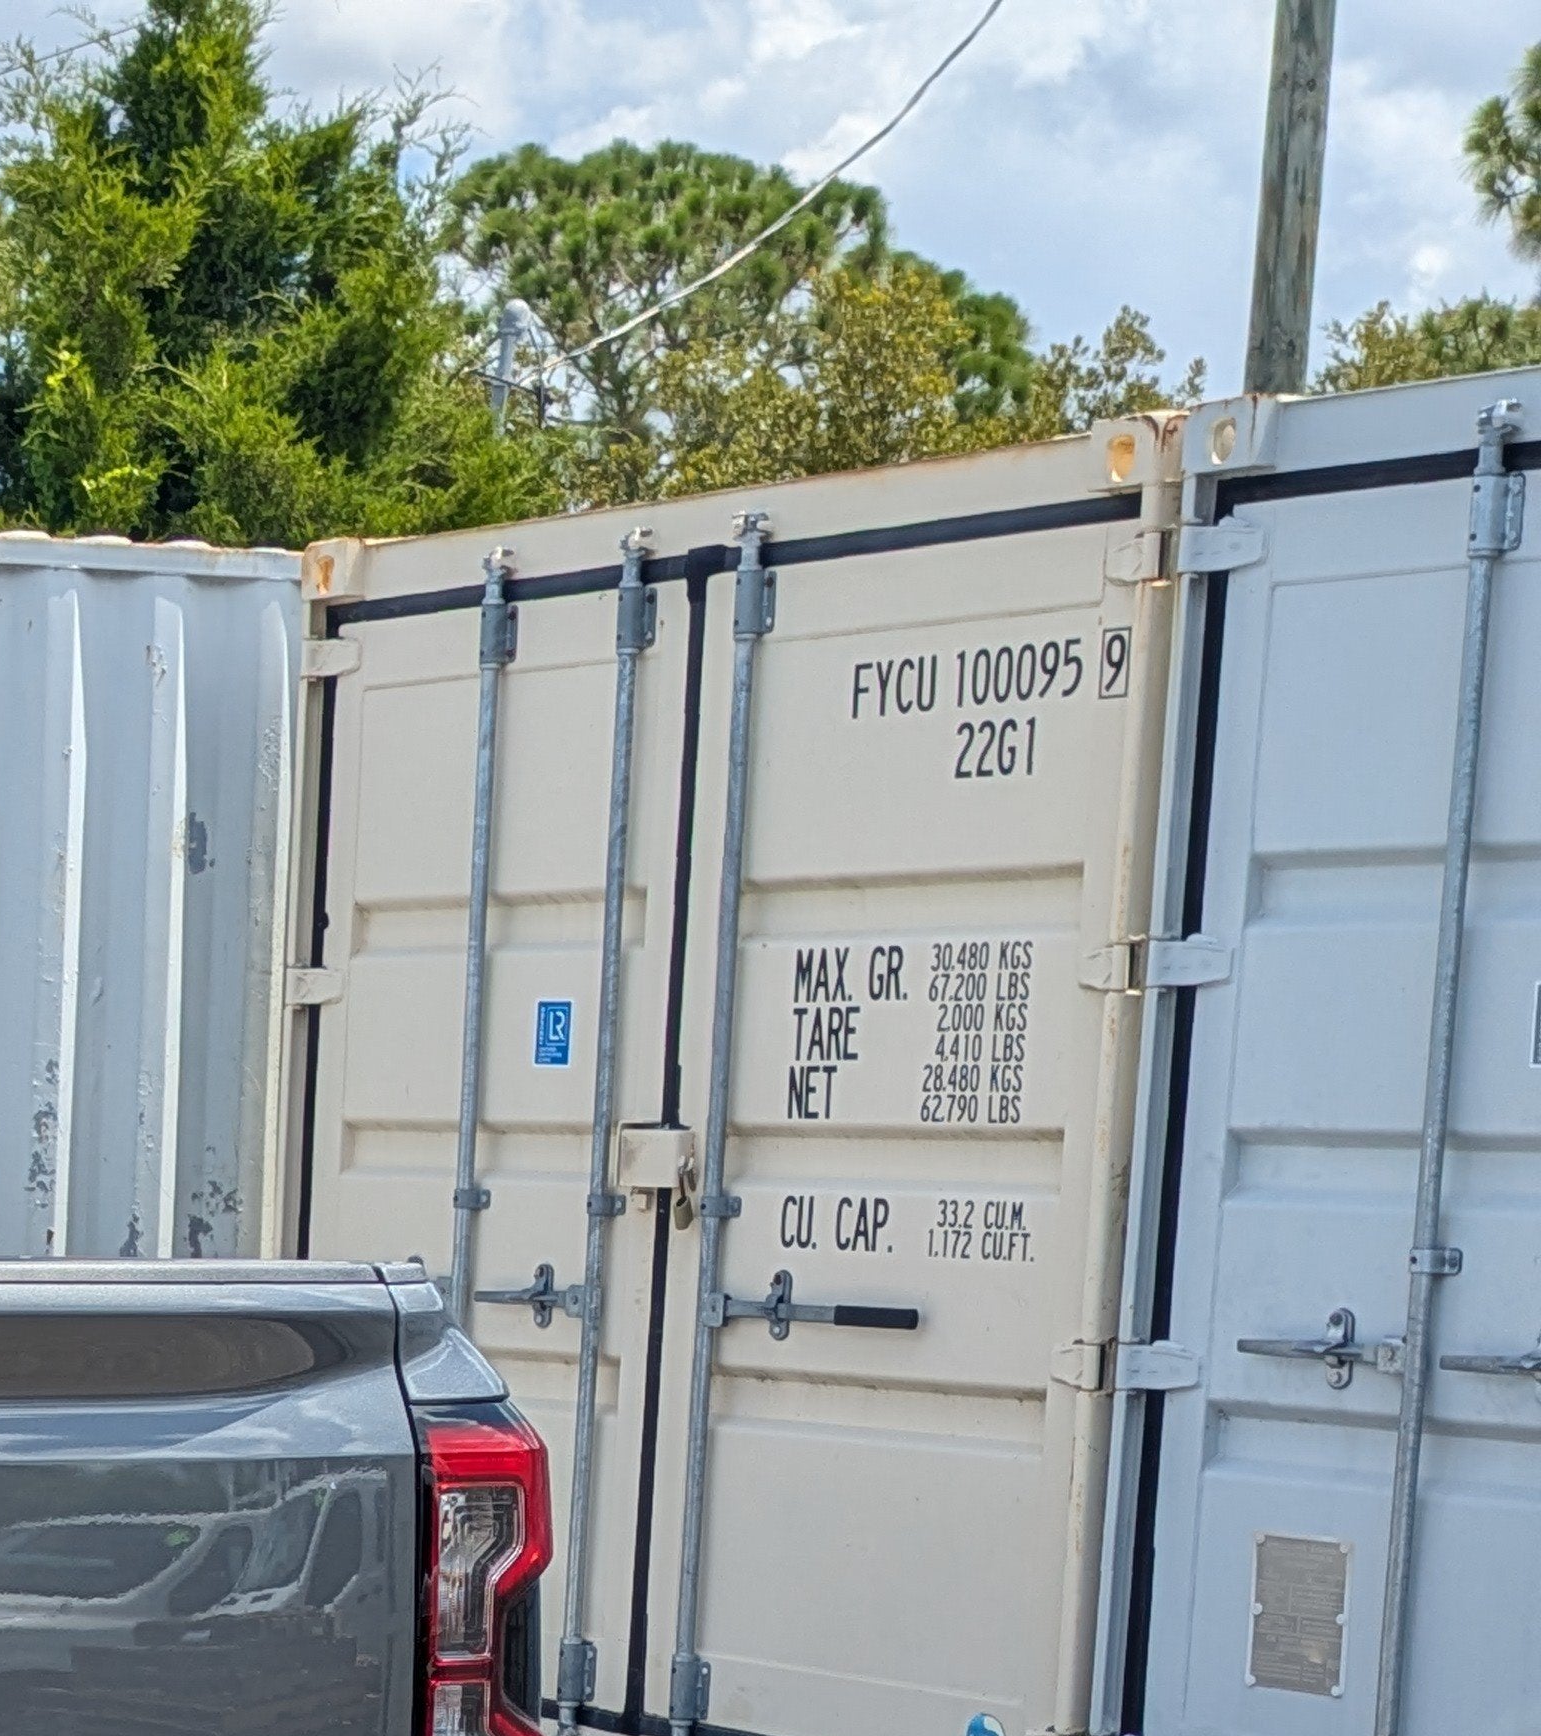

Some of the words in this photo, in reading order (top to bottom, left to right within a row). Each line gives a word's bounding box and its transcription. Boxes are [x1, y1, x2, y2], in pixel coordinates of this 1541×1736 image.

[850, 653, 939, 720] FYCU
[954, 638, 1084, 709] 100095
[1102, 631, 1129, 695] 9
[953, 716, 1037, 780] 22G1
[930, 941, 991, 972] 30.480
[998, 940, 1034, 971] KGS
[793, 947, 853, 1003] MAX.
[868, 945, 909, 1001] GR.
[995, 972, 1031, 1002] LBS
[993, 1003, 1029, 1032] KGS
[793, 1006, 861, 1062] TARE
[991, 1033, 1027, 1063] LBS
[787, 1065, 838, 1120] NET
[921, 1064, 981, 1093] 28.480
[989, 1064, 1024, 1093] KGS
[987, 1095, 1022, 1124] LBS
[780, 1195, 818, 1250] CU.
[834, 1196, 894, 1254] CAP.
[936, 1199, 975, 1229] 33.2
